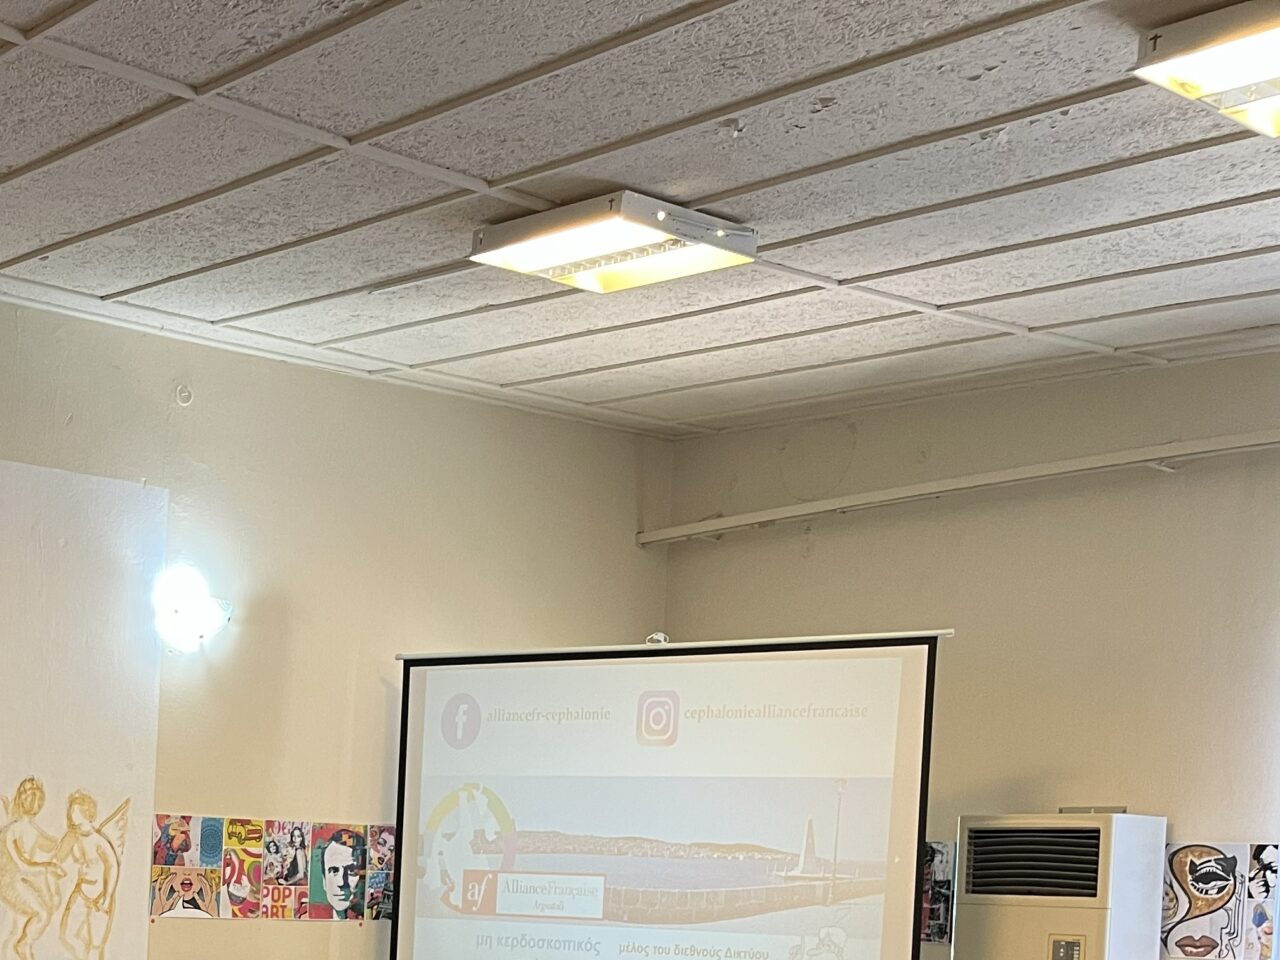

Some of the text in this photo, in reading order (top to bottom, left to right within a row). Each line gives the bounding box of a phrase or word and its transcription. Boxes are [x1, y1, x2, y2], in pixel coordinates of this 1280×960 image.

[486, 705, 611, 724] alliancefr-cephalonie
[476, 933, 601, 956] μη κερδοσκοπικός
[618, 941, 770, 960] μέλος του διεθνούς Δικτύου
